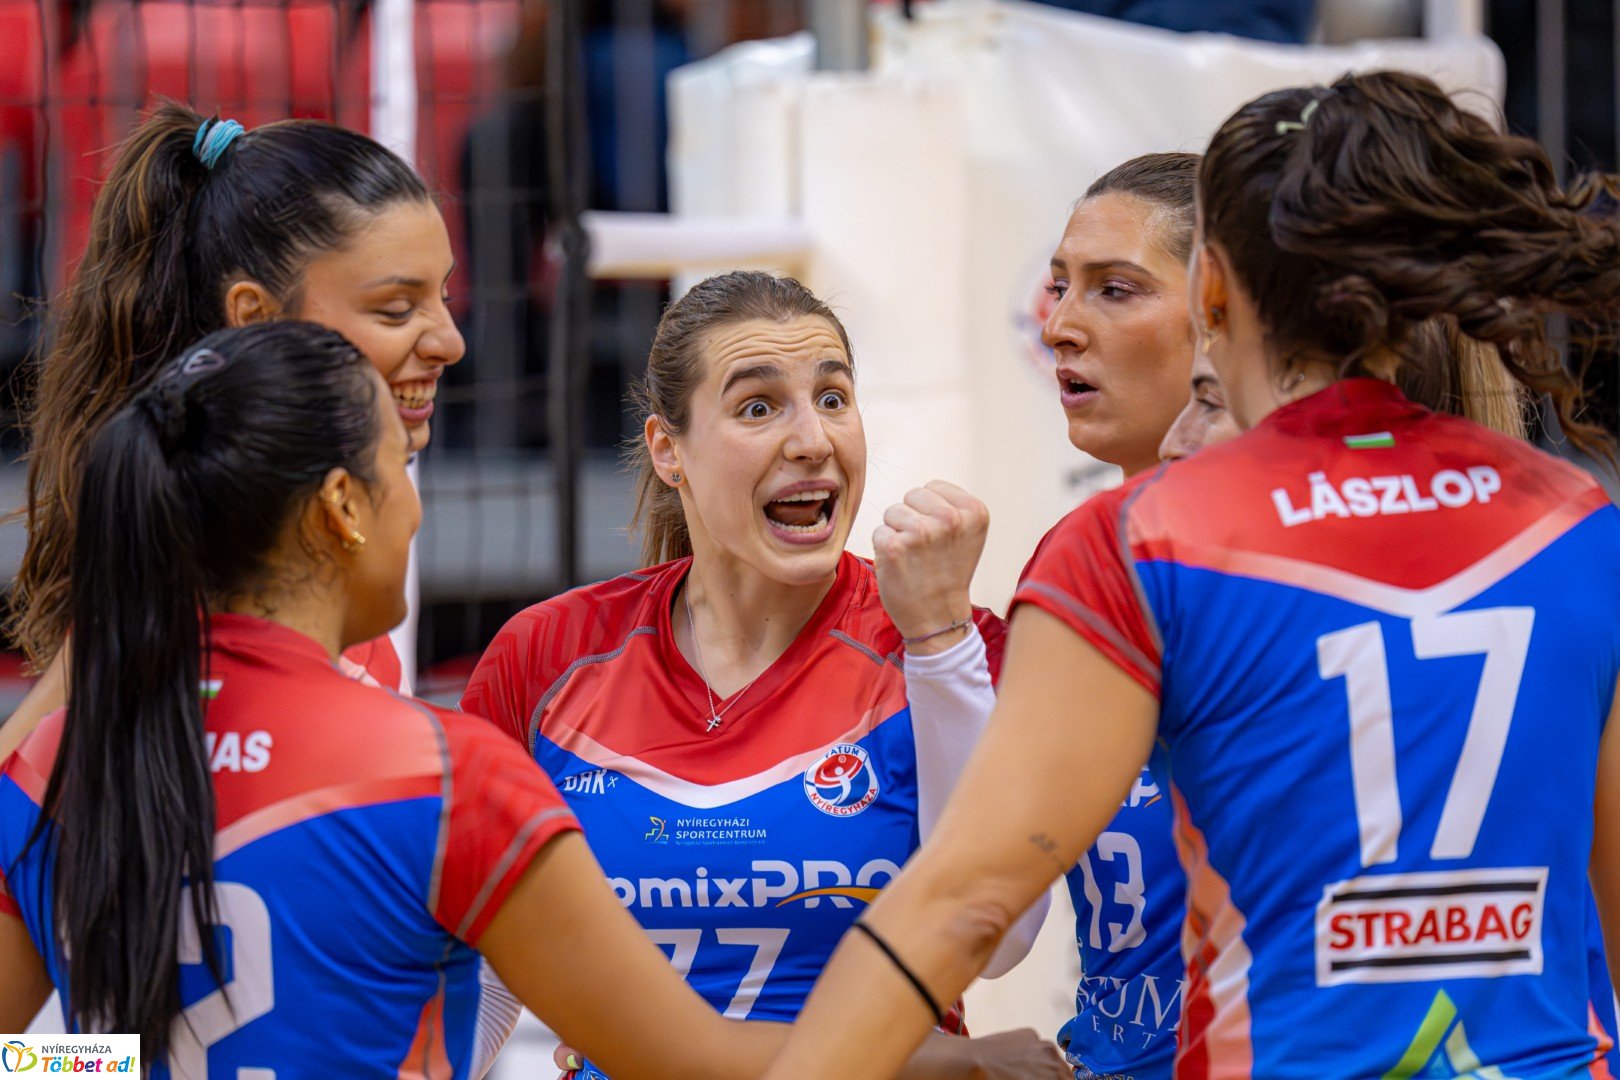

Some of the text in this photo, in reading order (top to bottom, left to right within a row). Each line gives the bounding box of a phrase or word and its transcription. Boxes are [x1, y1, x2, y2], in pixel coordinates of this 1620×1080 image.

[1271, 465, 1502, 528] LÁSZLOP
[1317, 606, 1535, 865] 17
[676, 817, 750, 828] NYÍREGYHÁZI
[676, 829, 767, 839] SPORTCENTRUM
[1078, 831, 1148, 954] 13
[1329, 902, 1533, 951] STRABAG
